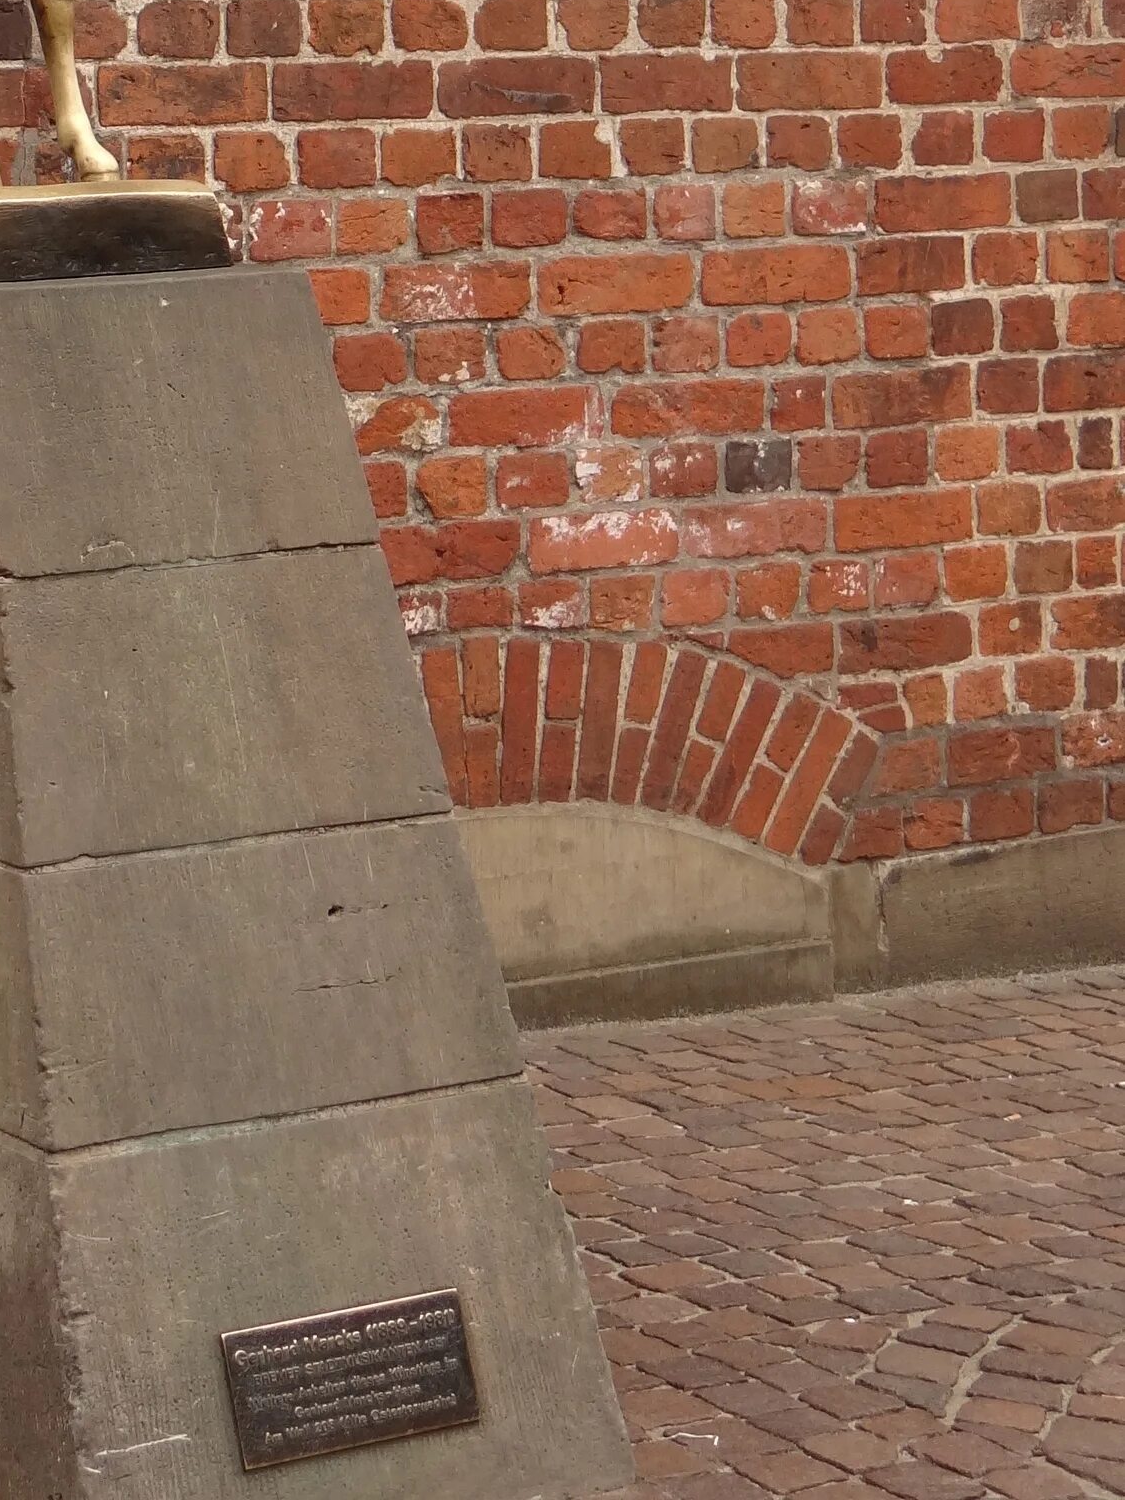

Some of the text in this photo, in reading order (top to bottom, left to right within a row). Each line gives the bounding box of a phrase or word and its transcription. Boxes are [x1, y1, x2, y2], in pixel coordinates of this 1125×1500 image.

[235, 1340, 298, 1366] Gerhard
[303, 1329, 361, 1351] Marcks
[253, 1366, 302, 1385] BREMER
[305, 1341, 419, 1374] STADTMUSIKANTEN
[298, 1379, 347, 1397] Arbeiten
[350, 1370, 386, 1387] dieses
[294, 1399, 340, 1417] Gerhard
[265, 1430, 283, 1443] Am
[285, 1424, 312, 1438] Wall
